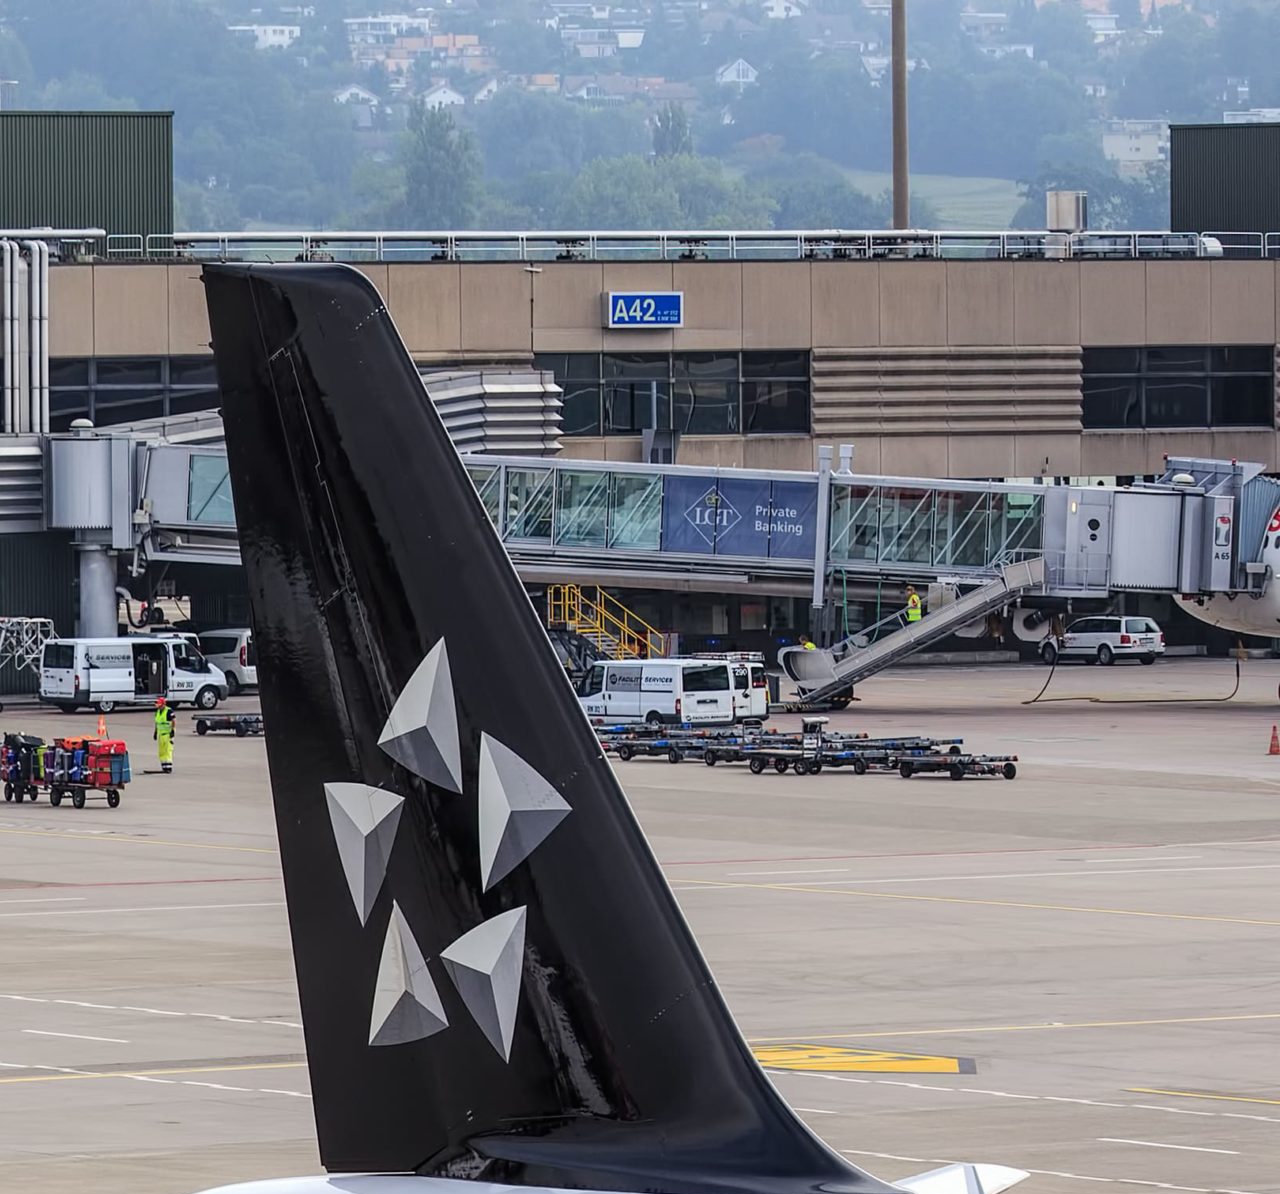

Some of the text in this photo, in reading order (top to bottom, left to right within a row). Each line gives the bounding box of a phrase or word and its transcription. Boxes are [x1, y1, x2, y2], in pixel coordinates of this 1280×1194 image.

[613, 298, 656, 322] A42
[695, 507, 733, 526] LGT
[755, 505, 797, 518] Private
[754, 520, 803, 536] Banking
[1214, 552, 1230, 560] A 65
